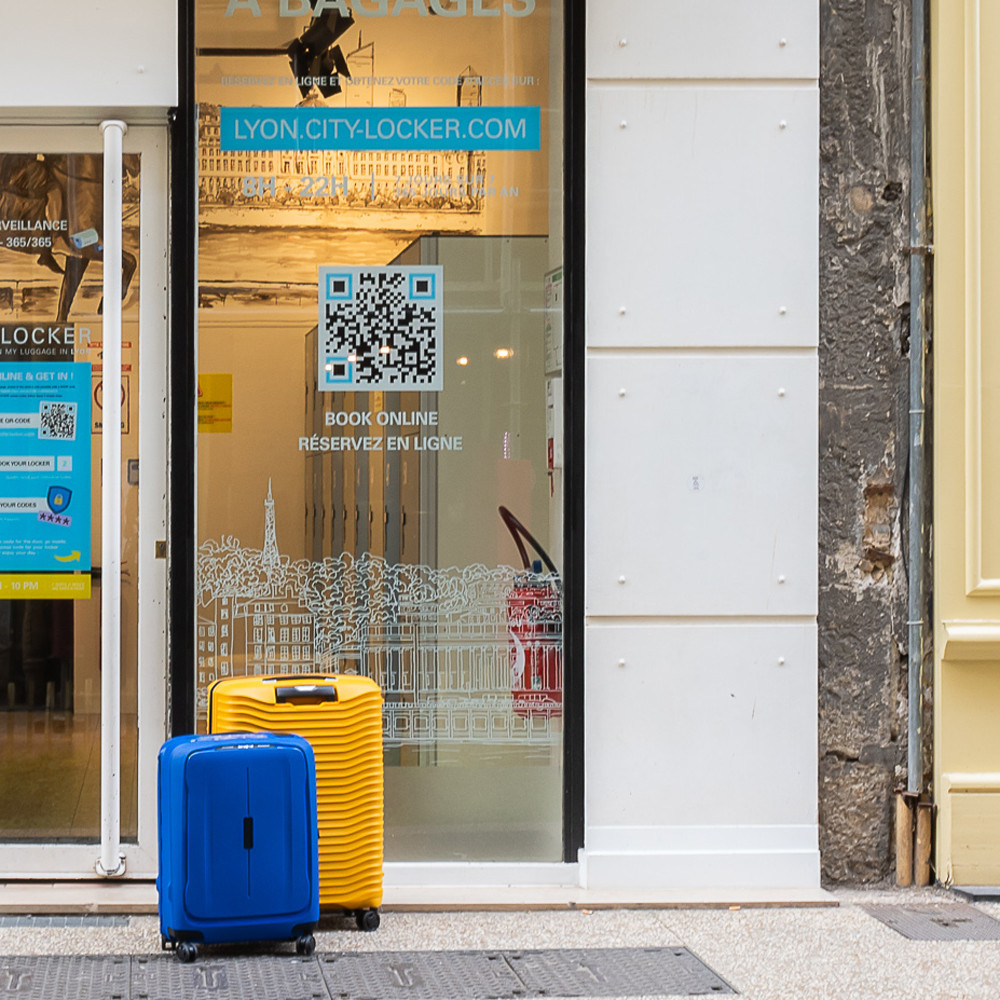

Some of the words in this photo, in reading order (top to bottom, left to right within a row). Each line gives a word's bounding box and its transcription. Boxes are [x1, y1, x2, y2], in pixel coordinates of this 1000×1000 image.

[278, 75, 293, 87] EN
[296, 75, 327, 87] LIGNE
[329, 75, 341, 87] ET
[344, 75, 394, 87] OBTENEZ
[396, 75, 430, 87] VOTRE
[432, 75, 462, 87] CODE
[512, 75, 534, 87] SUR
[234, 118, 527, 139] LYON.CITY-LOCKER.COM
[406, 175, 451, 185] JOURS
[456, 175, 484, 185] SUR
[489, 175, 496, 185] 7
[241, 175, 276, 198] 8H
[299, 175, 349, 198] 22H
[471, 187, 496, 197] PAR
[499, 187, 519, 197] AN
[6, 237, 52, 248] 365/365
[1, 327, 91, 345] LOCKER
[5, 348, 17, 356] MY
[20, 348, 57, 356] LUGGAGE
[60, 348, 68, 356] IN
[25, 372, 33, 381] &
[35, 372, 54, 381] GET
[57, 372, 68, 381] IN
[325, 411, 372, 426] BOOK
[376, 411, 438, 426] ONLINE
[298, 434, 383, 451] RÉSERVEZ
[387, 437, 409, 451] EN
[414, 437, 463, 451] LIGNE
[11, 581, 21, 590] 10
[23, 581, 39, 590] PM
